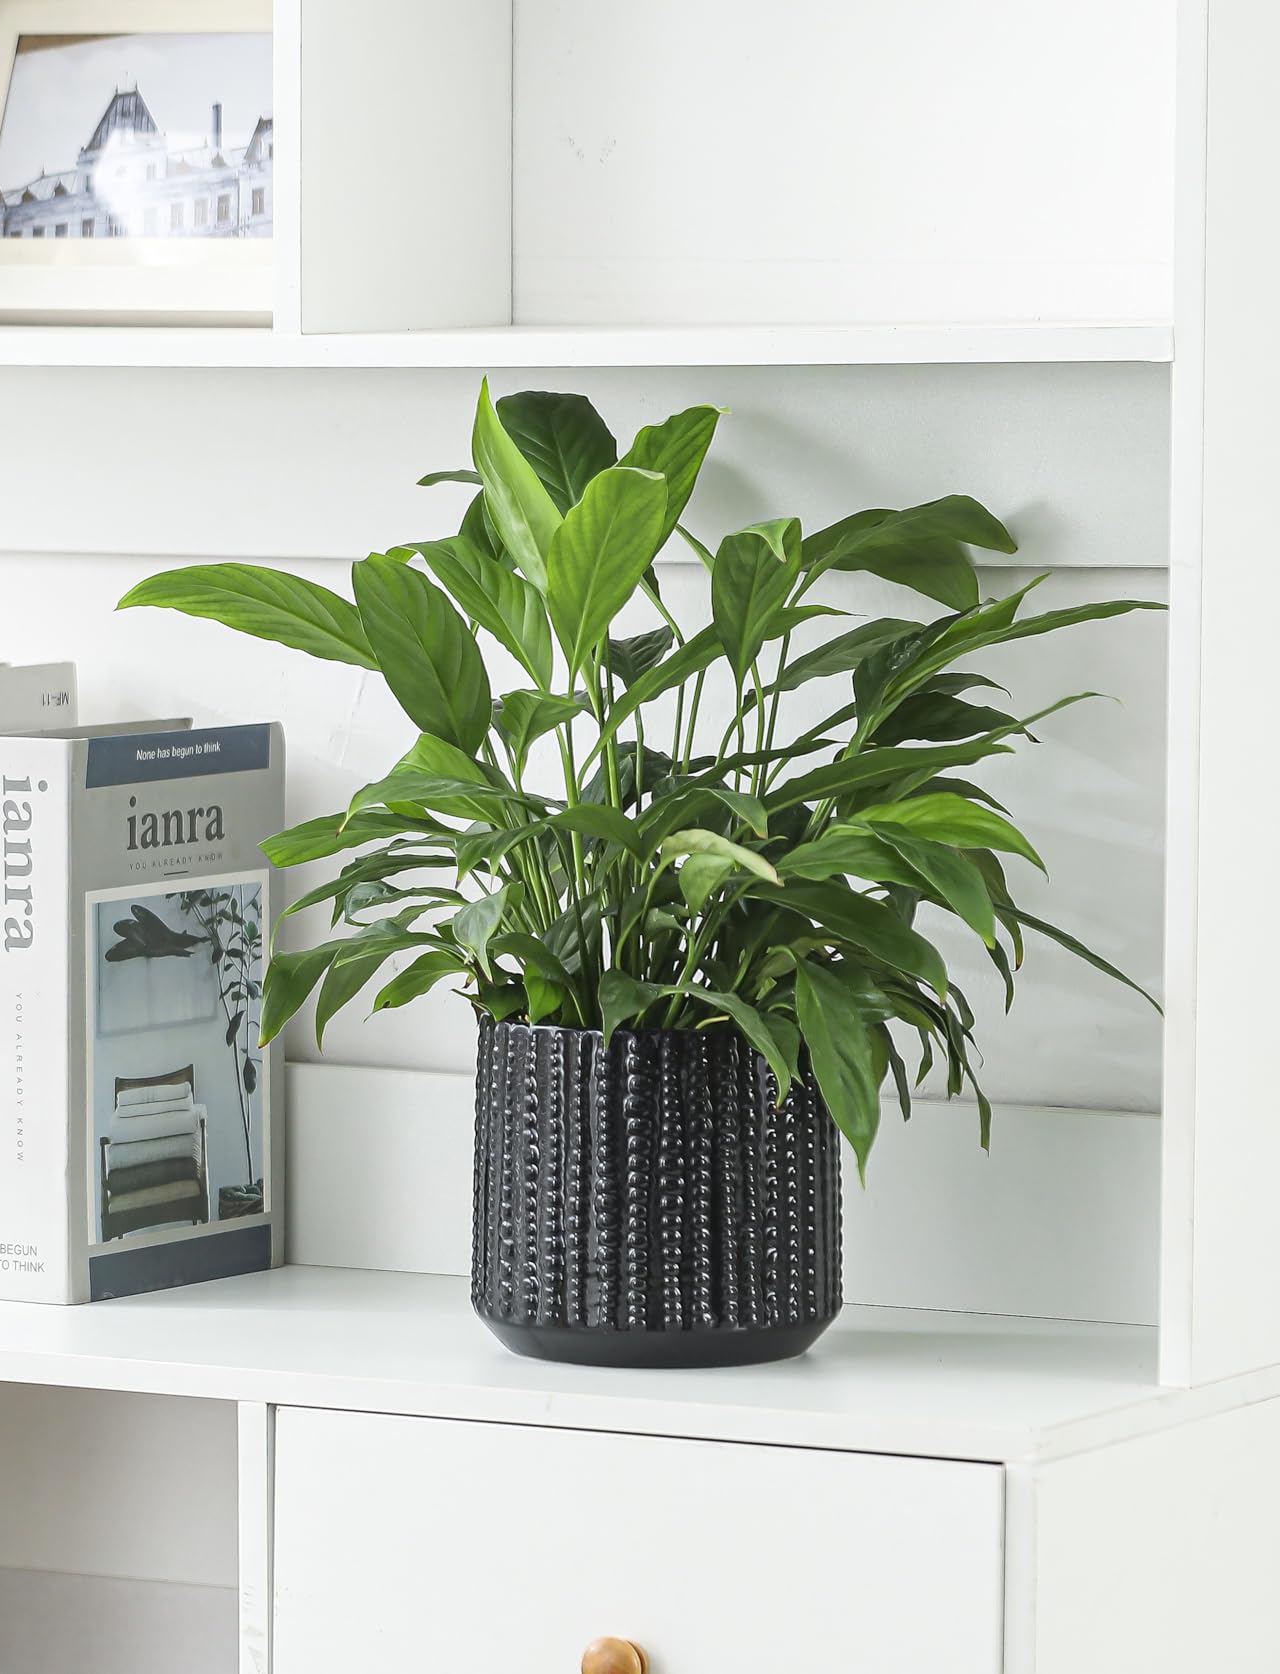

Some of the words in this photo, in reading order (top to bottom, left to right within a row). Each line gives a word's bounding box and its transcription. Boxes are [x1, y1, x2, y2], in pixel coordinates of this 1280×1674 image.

[136, 749, 156, 761] None
[157, 747, 170, 759] has
[171, 745, 194, 759] begun
[195, 743, 203, 755] to
[203, 741, 221, 753] think
[126, 795, 225, 851] ianra
[2, 775, 48, 952] ianra
[129, 861, 147, 871] YOU
[152, 856, 193, 868] ALREADY
[15, 992, 23, 1024] YOU
[15, 1034, 24, 1107] ALREADY
[16, 1117, 25, 1163] KNOW
[0, 1243, 38, 1257] BEGUN
[12, 1260, 45, 1273] THINK
